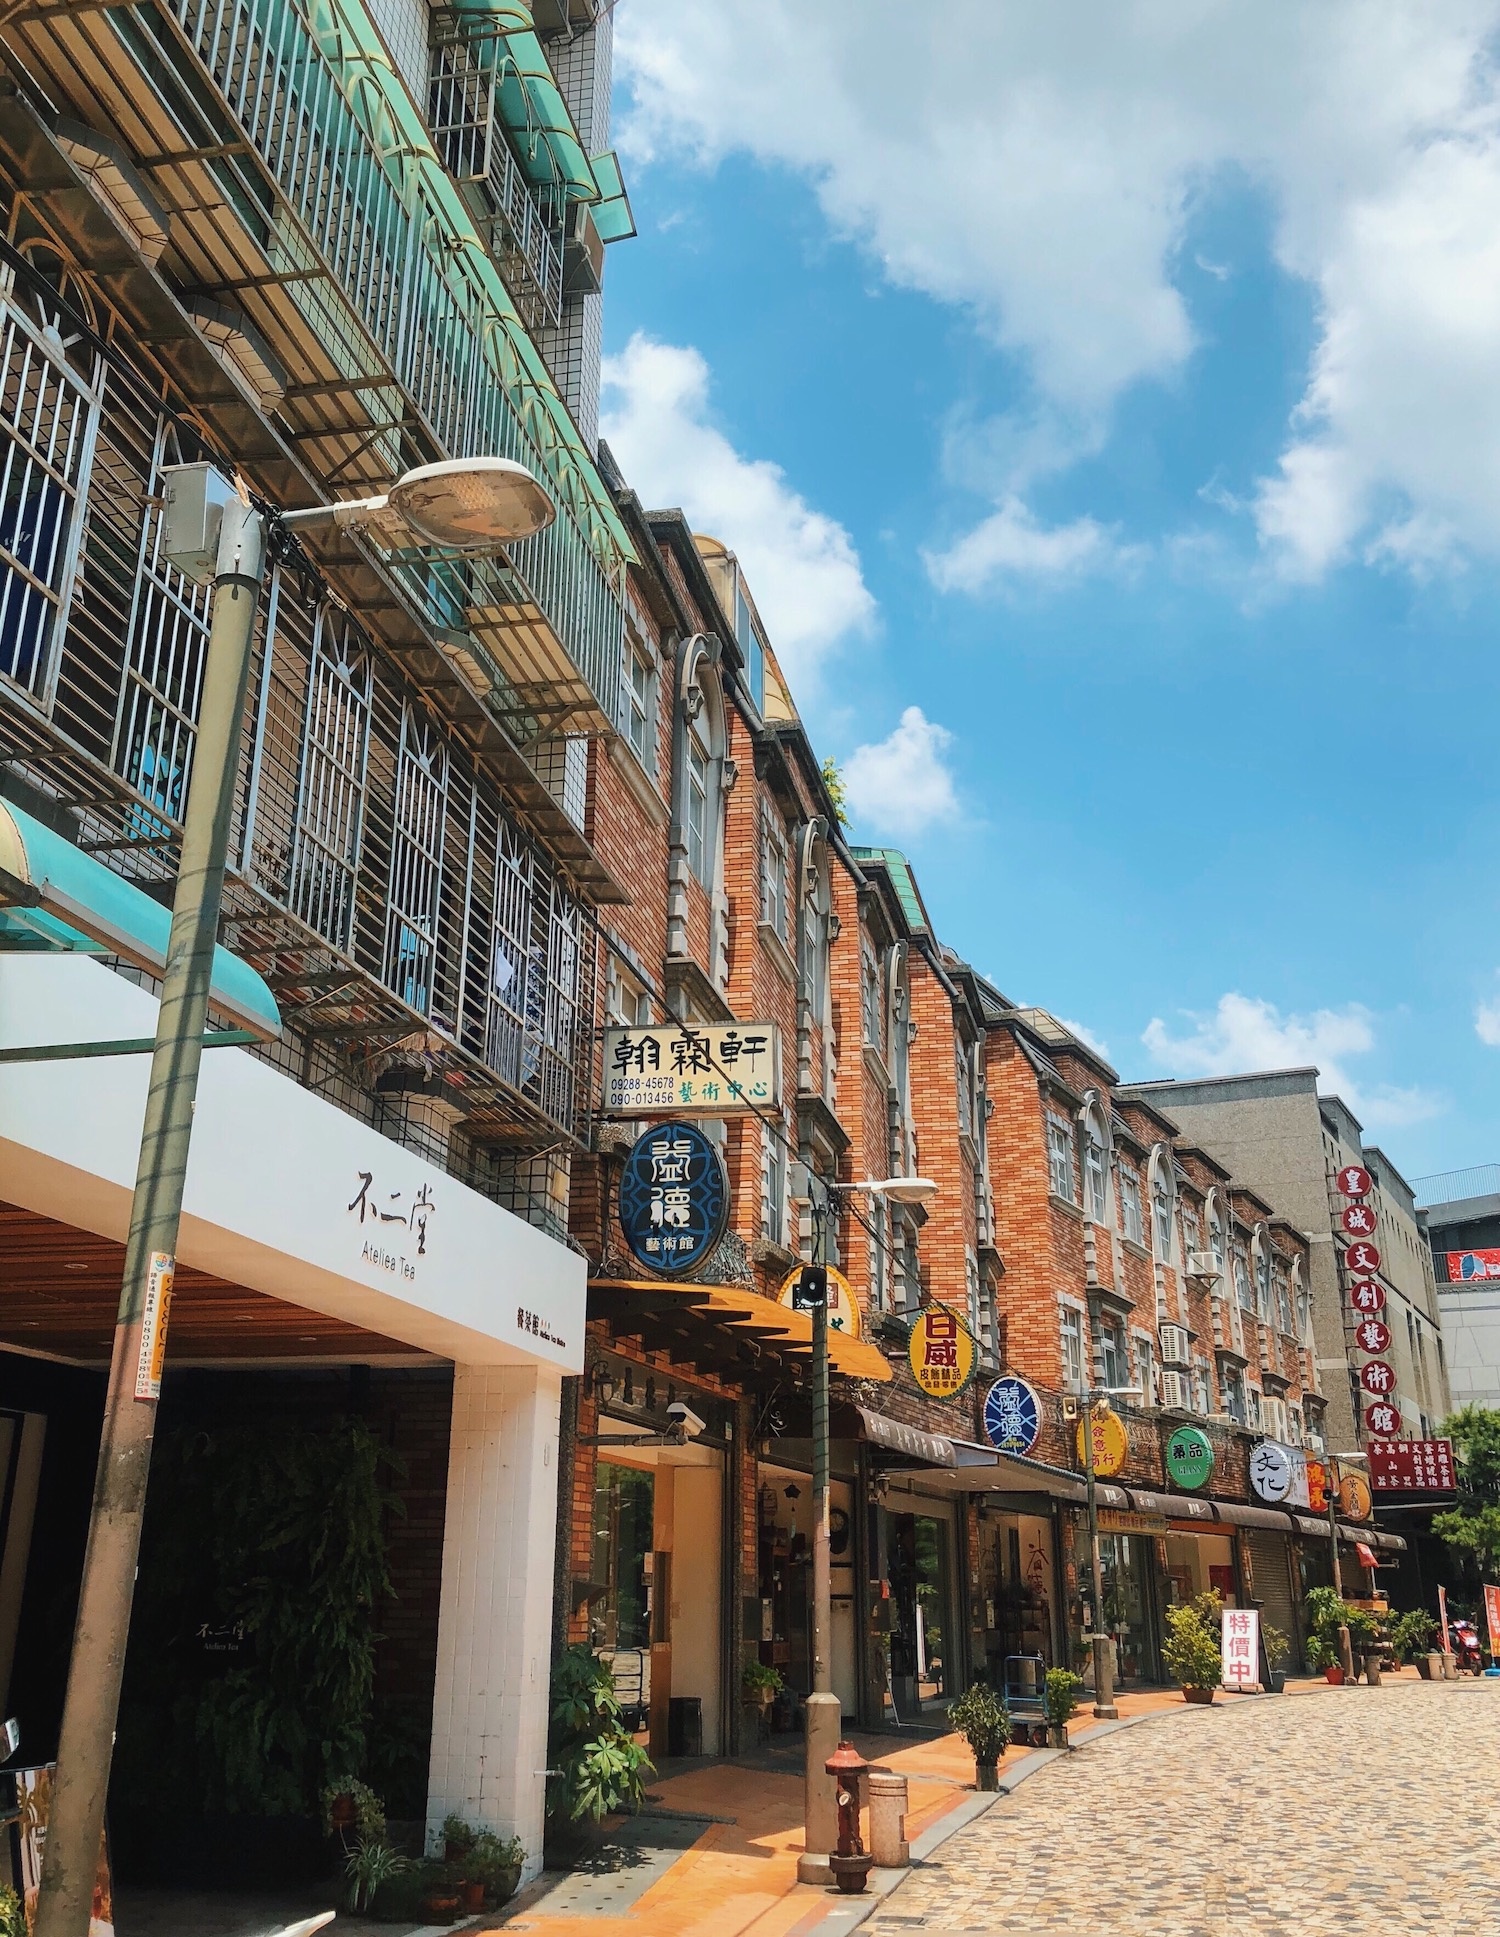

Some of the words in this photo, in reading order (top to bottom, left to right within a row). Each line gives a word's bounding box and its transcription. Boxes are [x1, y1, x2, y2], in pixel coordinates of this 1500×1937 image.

[611, 1077, 674, 1090] 09288-45678
[611, 1092, 674, 1105] 090-013456
[678, 1081, 768, 1104] 藝術中心
[348, 1171, 436, 1255] 不二堂
[361, 1240, 397, 1272] Ateliea
[400, 1256, 416, 1280] Tea
[645, 1235, 695, 1252] 藝術館
[1346, 1169, 1396, 1433] 皇城文創藝術館
[924, 1312, 957, 1367] 日威
[1257, 1452, 1285, 1494] 文化
[1229, 1613, 1250, 1681] 特價中
